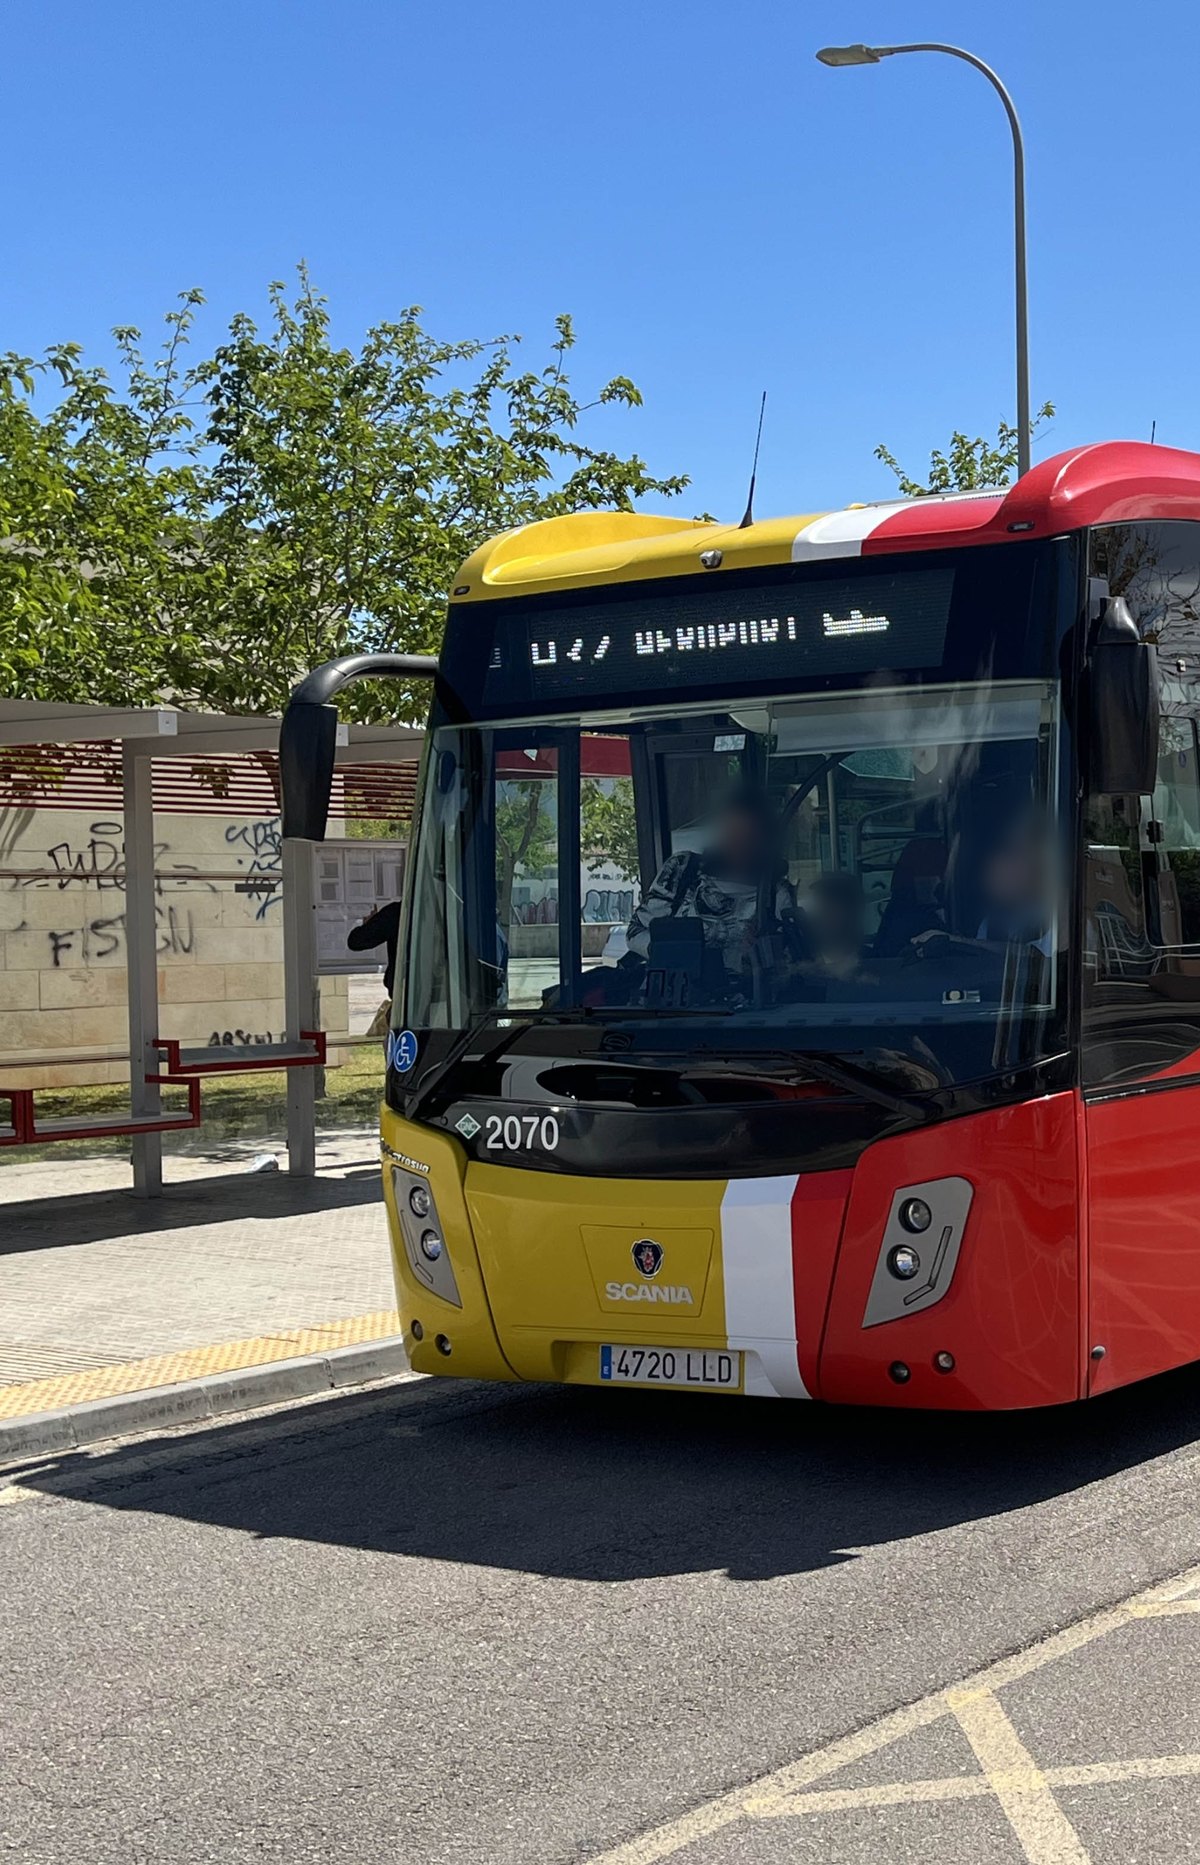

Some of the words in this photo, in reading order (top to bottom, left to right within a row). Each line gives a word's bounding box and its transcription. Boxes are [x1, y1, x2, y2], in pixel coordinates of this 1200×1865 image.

[485, 1115, 559, 1150] 2070
[605, 1282, 694, 1304] SCANIA
[617, 1349, 676, 1379] 4720
[686, 1353, 732, 1383] LLD
